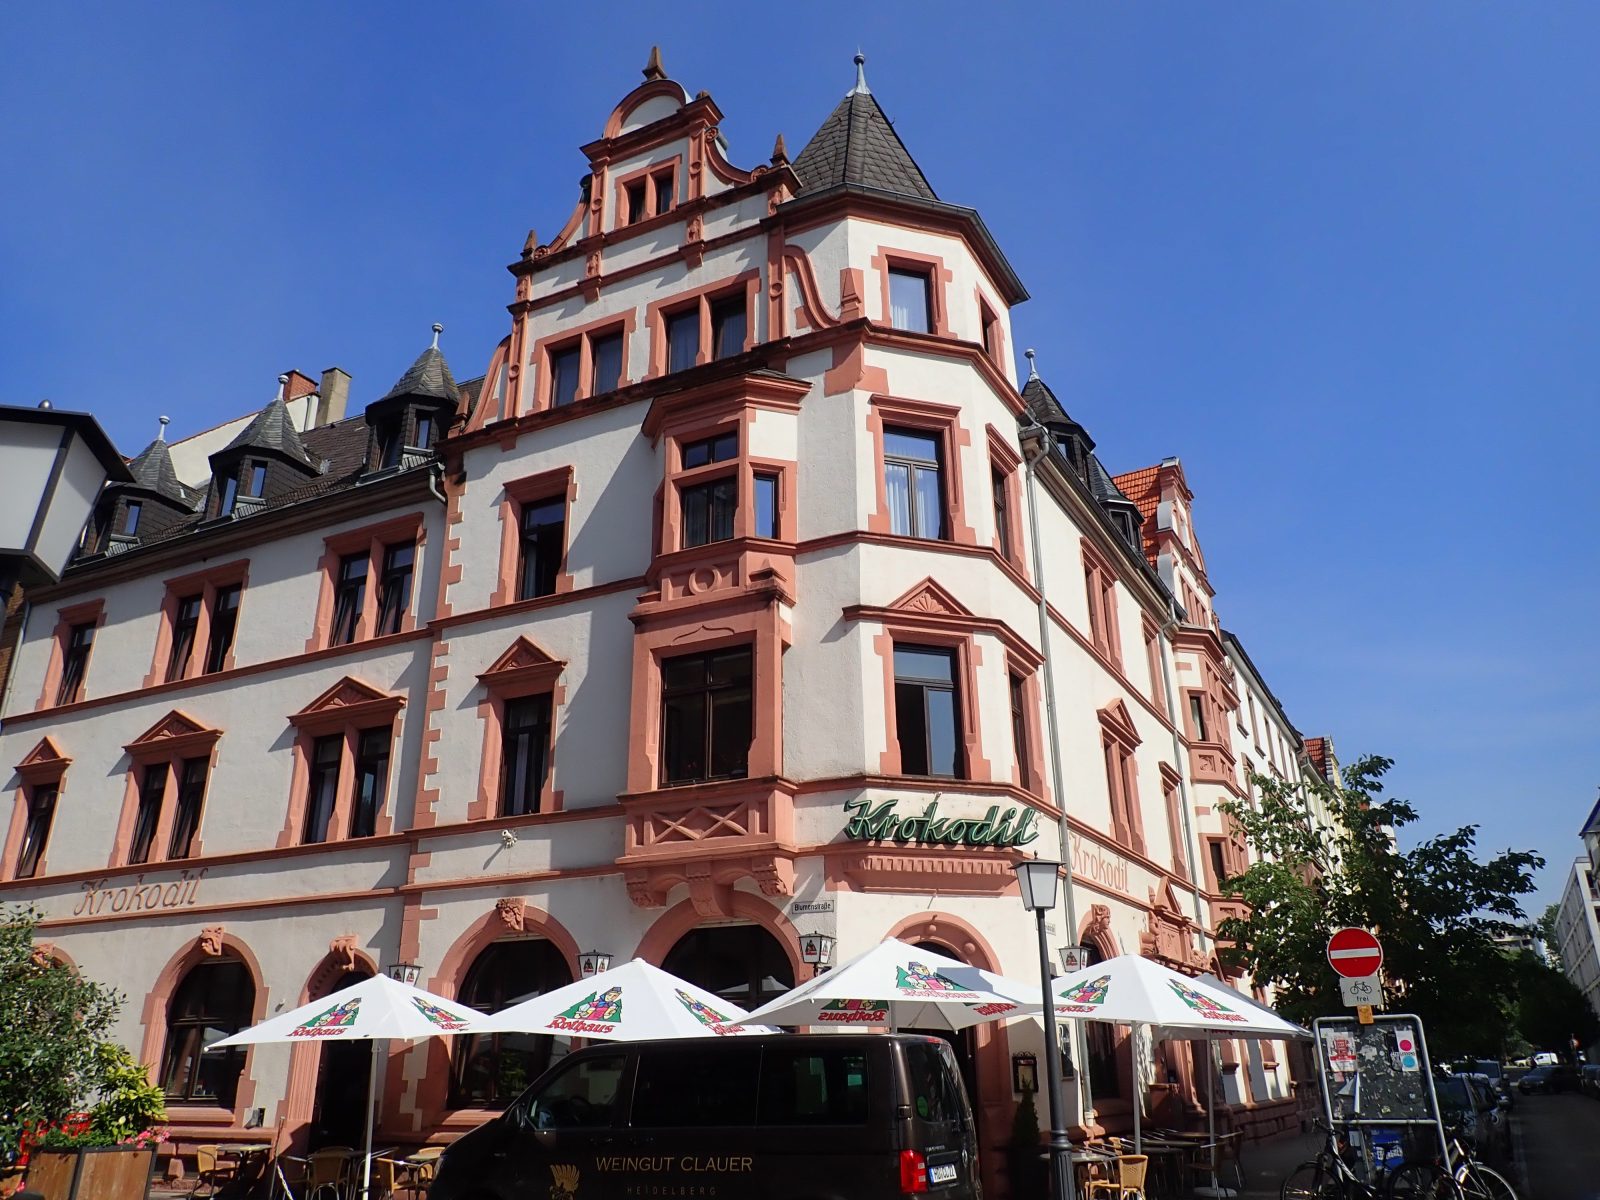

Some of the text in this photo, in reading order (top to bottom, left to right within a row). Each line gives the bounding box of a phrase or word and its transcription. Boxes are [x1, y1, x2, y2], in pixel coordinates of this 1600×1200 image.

[844, 798, 1040, 848] Krokodil
[1068, 831, 1130, 893] Krokodil
[74, 867, 208, 916] Krokodil
[286, 1026, 347, 1038] Rothaus
[544, 1016, 616, 1034] Rothaus
[596, 1156, 753, 1172] WEINGUT CLAUER
[627, 1185, 717, 1196] HEIDELBERG
